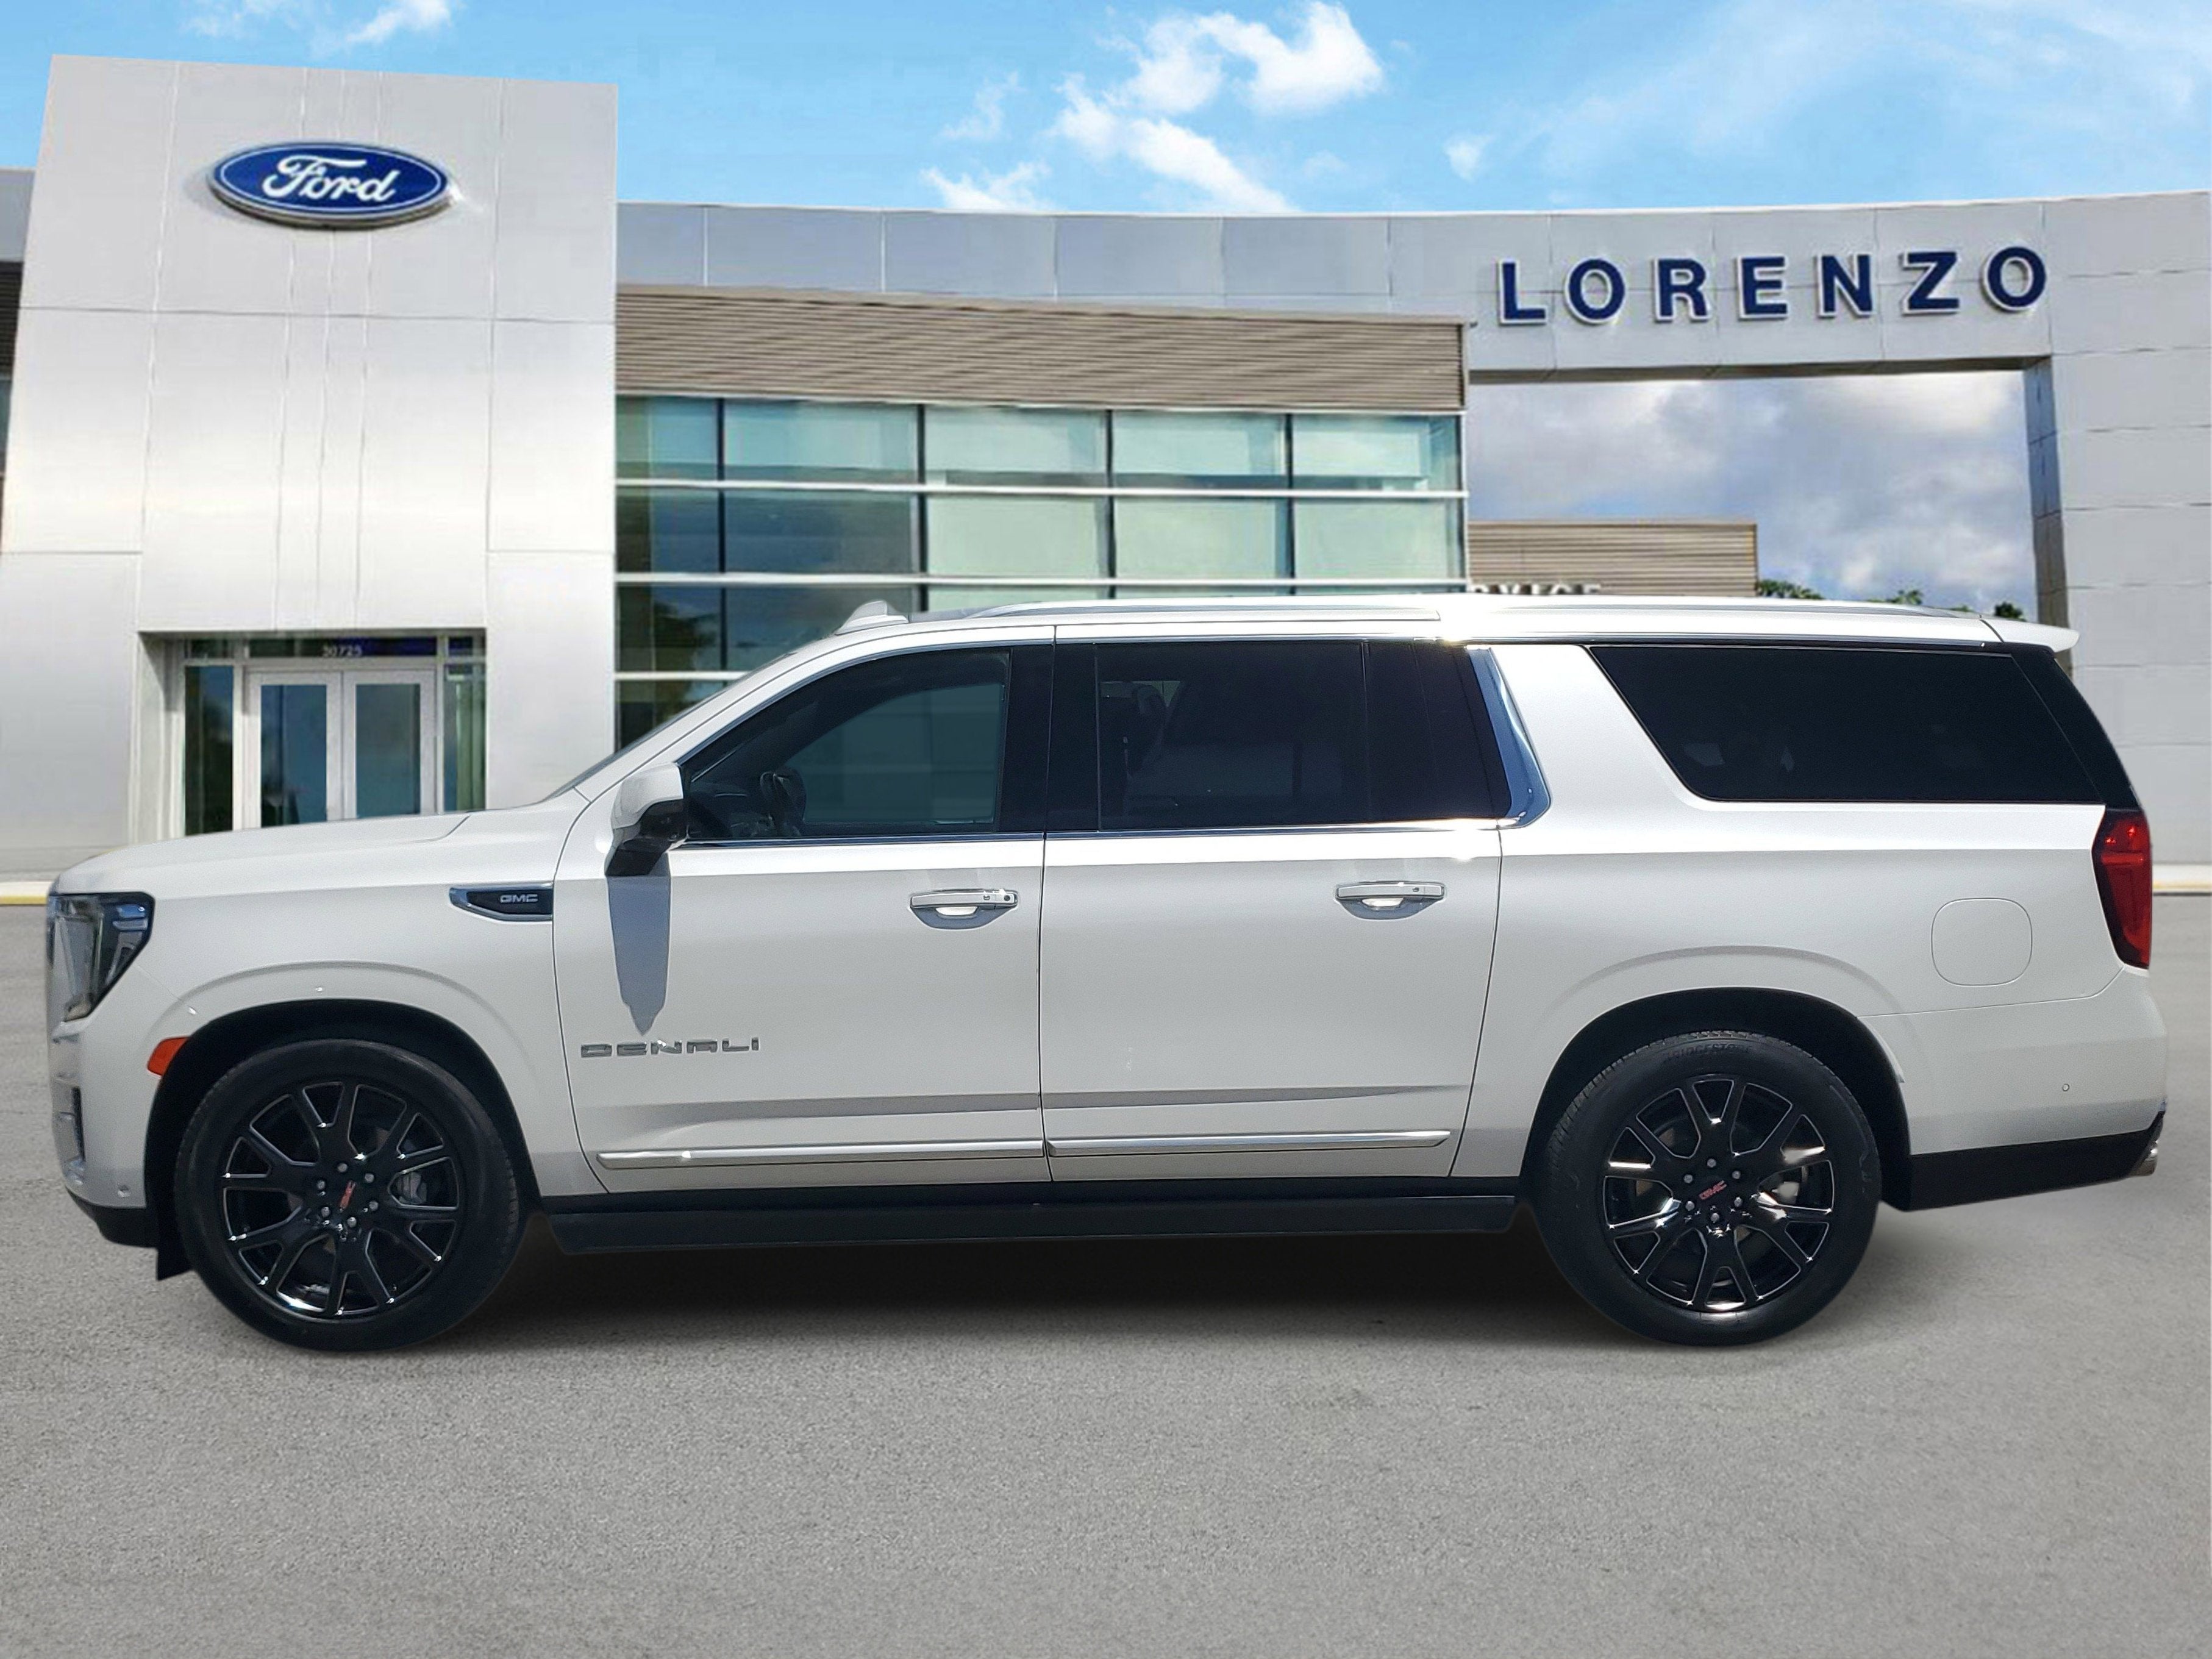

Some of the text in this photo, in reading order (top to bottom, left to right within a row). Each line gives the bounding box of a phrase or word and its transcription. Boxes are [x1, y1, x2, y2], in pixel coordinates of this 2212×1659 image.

[262, 154, 401, 202] Ford
[1498, 246, 2047, 326] LORENZO
[499, 893, 539, 904] GMC
[580, 1037, 759, 1058] DENALI
[1699, 1180, 1727, 1200] GMC
